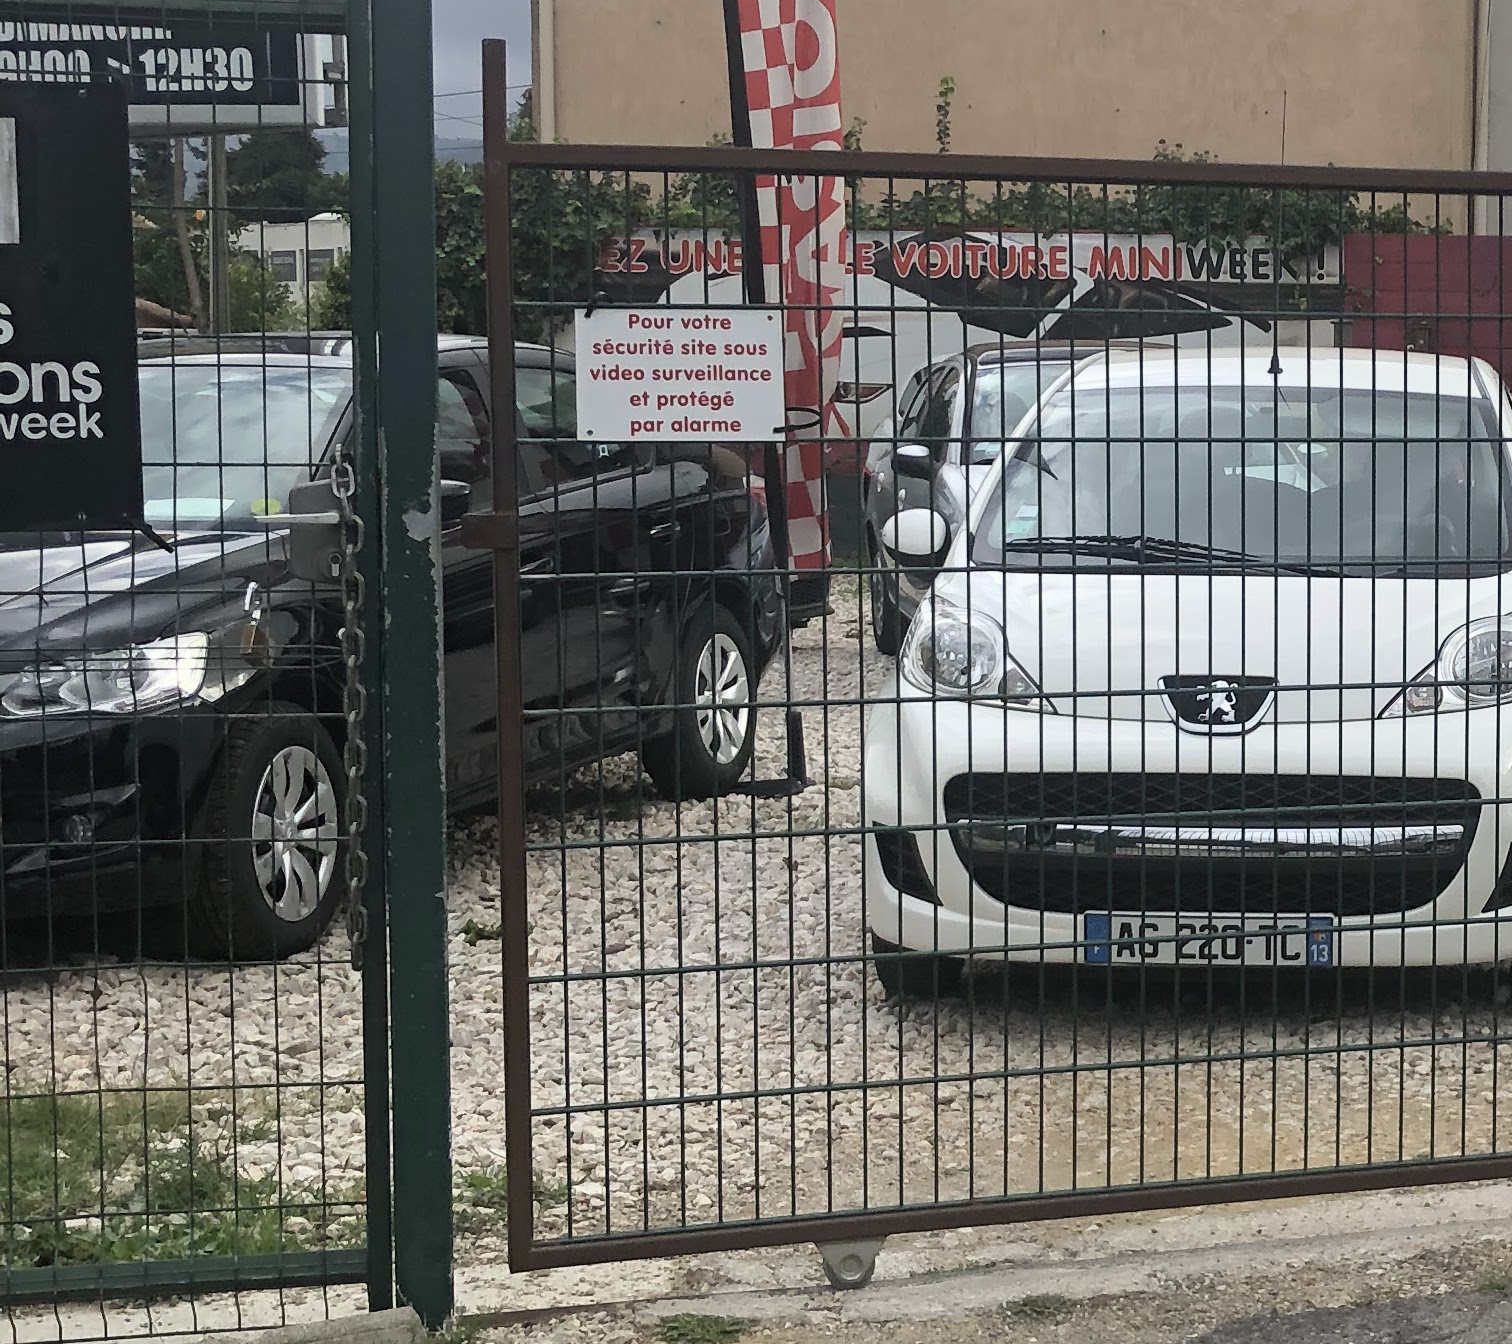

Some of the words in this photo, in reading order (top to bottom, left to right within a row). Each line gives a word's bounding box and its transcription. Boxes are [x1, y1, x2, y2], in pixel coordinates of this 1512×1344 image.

[139, 47, 254, 91] 12H30
[891, 241, 1070, 280] VOITURE
[628, 313, 675, 330] Pour
[681, 314, 732, 330] votre
[592, 338, 674, 355] sécurité
[681, 338, 717, 356] site
[724, 343, 768, 356] sous
[589, 364, 645, 381] video
[652, 364, 772, 381] surveillance
[629, 391, 650, 407] et
[657, 390, 735, 411] protégé
[630, 419, 664, 436] par
[671, 416, 742, 433] alarme
[1310, 944, 1330, 962] 13
